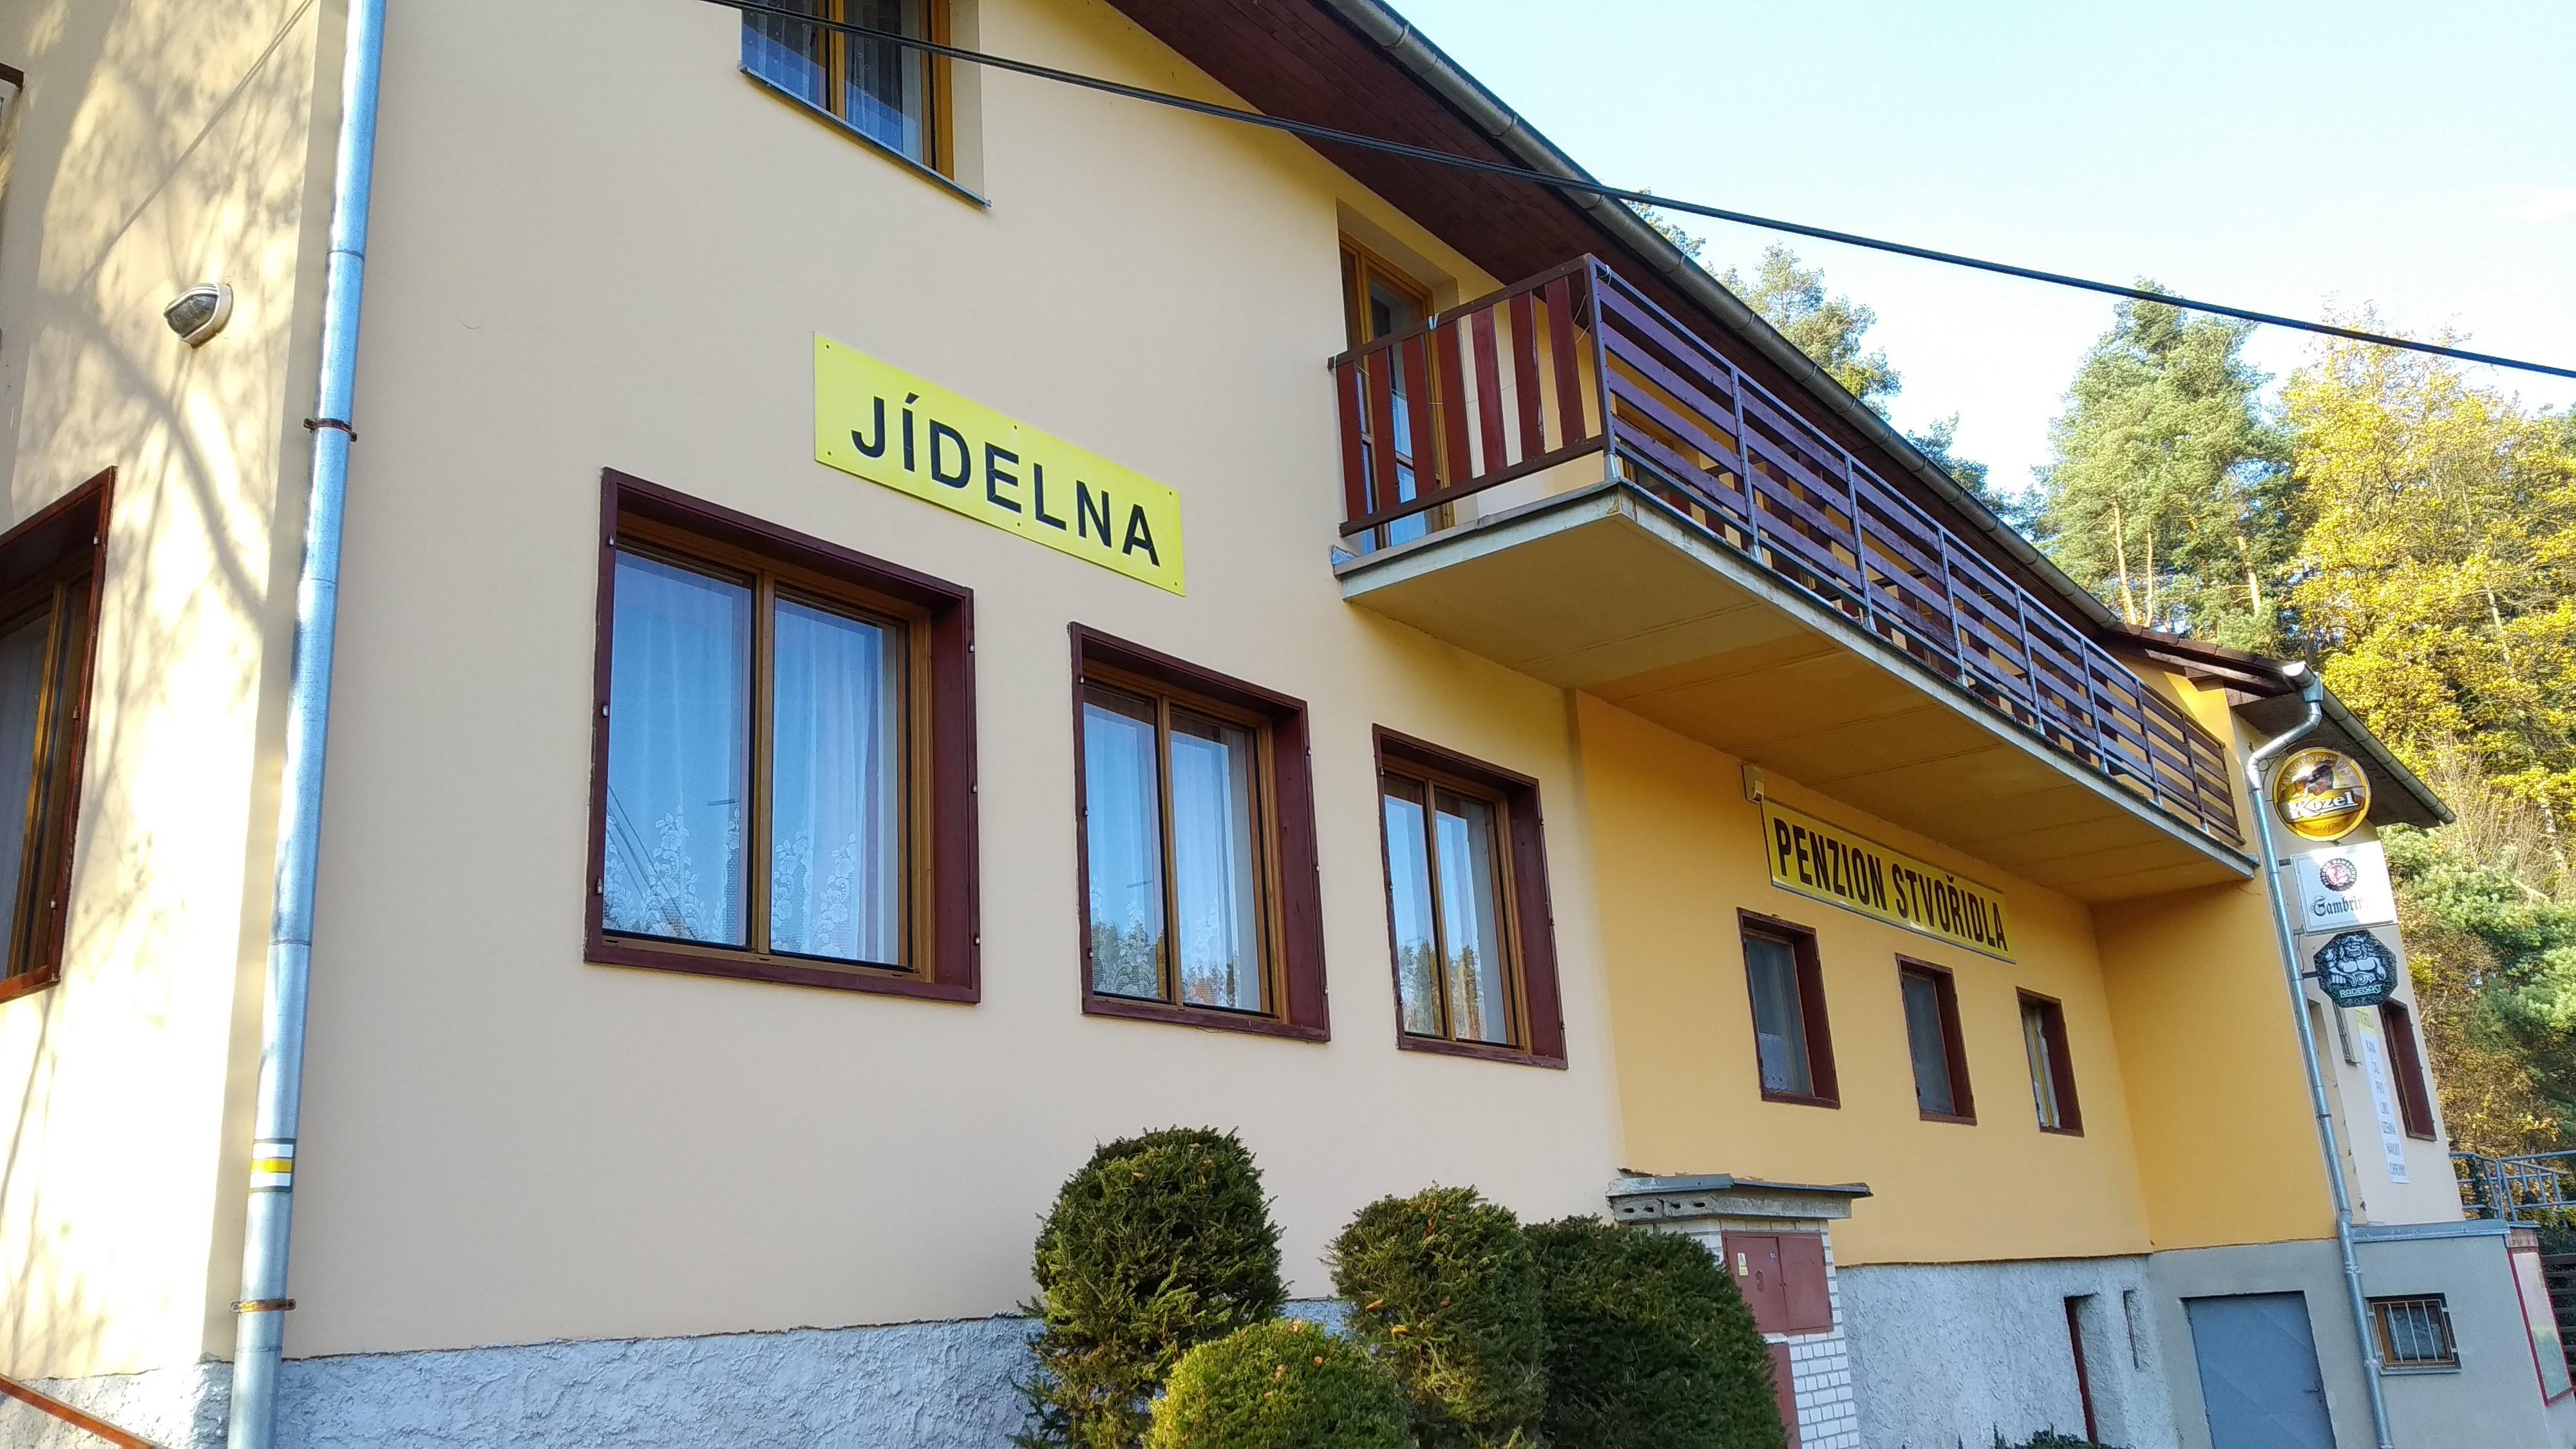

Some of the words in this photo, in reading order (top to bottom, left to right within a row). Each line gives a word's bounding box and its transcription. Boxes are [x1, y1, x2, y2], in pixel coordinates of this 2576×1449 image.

[851, 392, 1160, 568] JÍDELNA
[2287, 790, 2359, 820] Kozel
[1773, 817, 1888, 911] PENZION
[1891, 862, 2009, 952] STVOŘIDLA
[2339, 983, 2383, 999] RADEGAST
